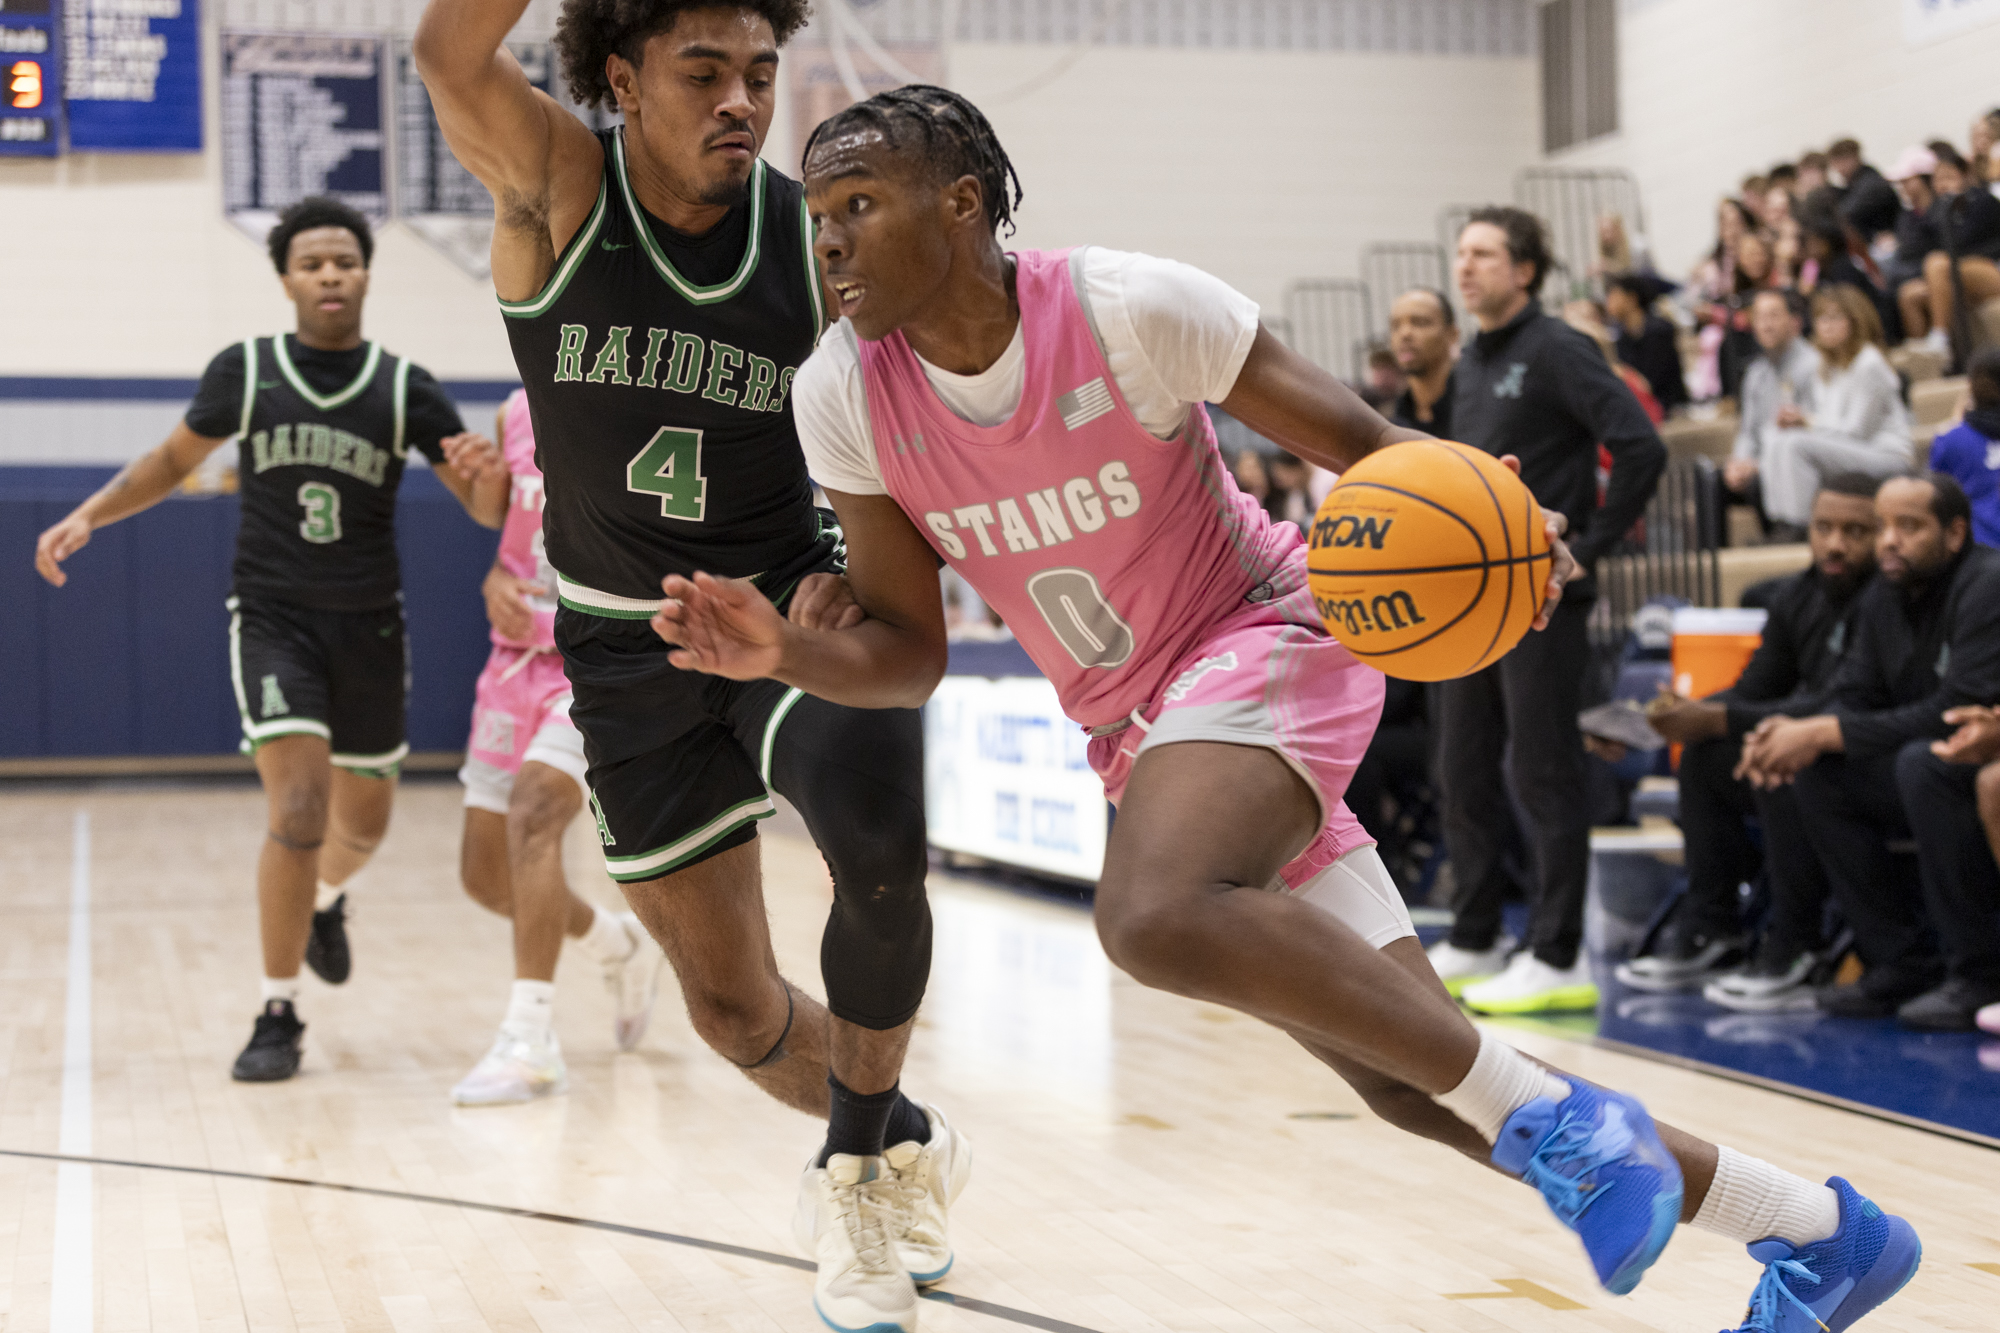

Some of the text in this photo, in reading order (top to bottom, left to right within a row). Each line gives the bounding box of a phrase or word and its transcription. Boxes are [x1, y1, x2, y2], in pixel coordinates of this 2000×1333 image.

[10, 60, 43, 109] 3
[554, 323, 798, 412] RAIDERS
[298, 481, 343, 544] 3
[626, 425, 708, 522] 4
[924, 460, 1142, 560] STANGS
[1025, 566, 1136, 670] 0
[258, 673, 291, 718] A
